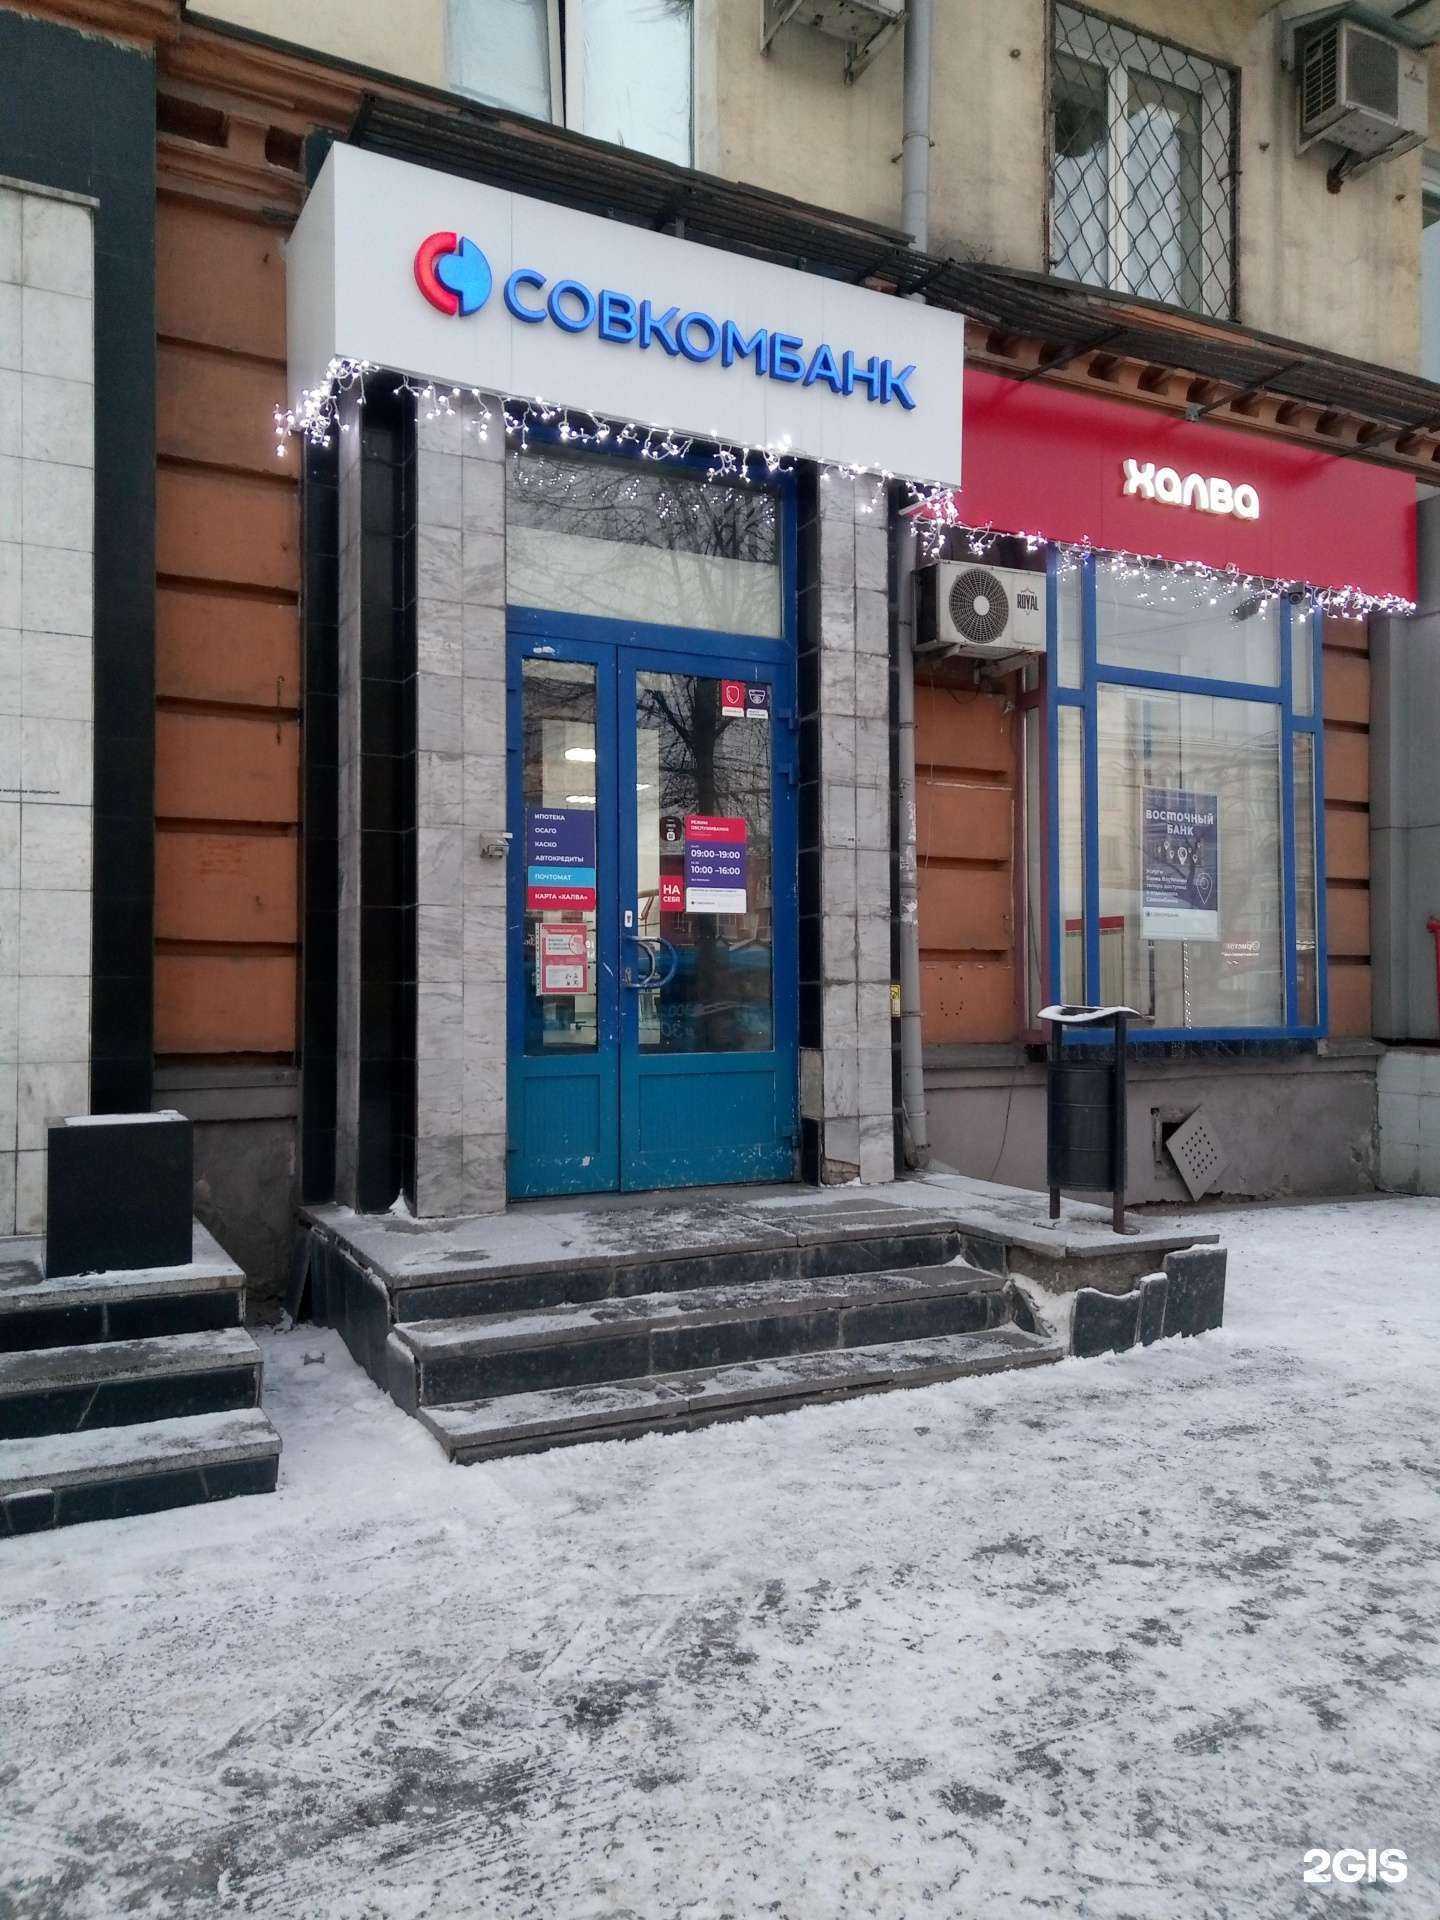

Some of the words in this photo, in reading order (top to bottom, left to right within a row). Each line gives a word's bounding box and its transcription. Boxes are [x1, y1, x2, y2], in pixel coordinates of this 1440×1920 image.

[503, 268, 917, 410] СОВКОМБАНК
[1016, 593, 1040, 611] ROYAL
[534, 813, 566, 821] ИПОТЕКА
[1145, 809, 1215, 825] ВОСТОЧНЫЙ
[1166, 824, 1194, 837] БАНК
[534, 873, 572, 881] ПОЧТОМАТ
[662, 884, 681, 895] НА
